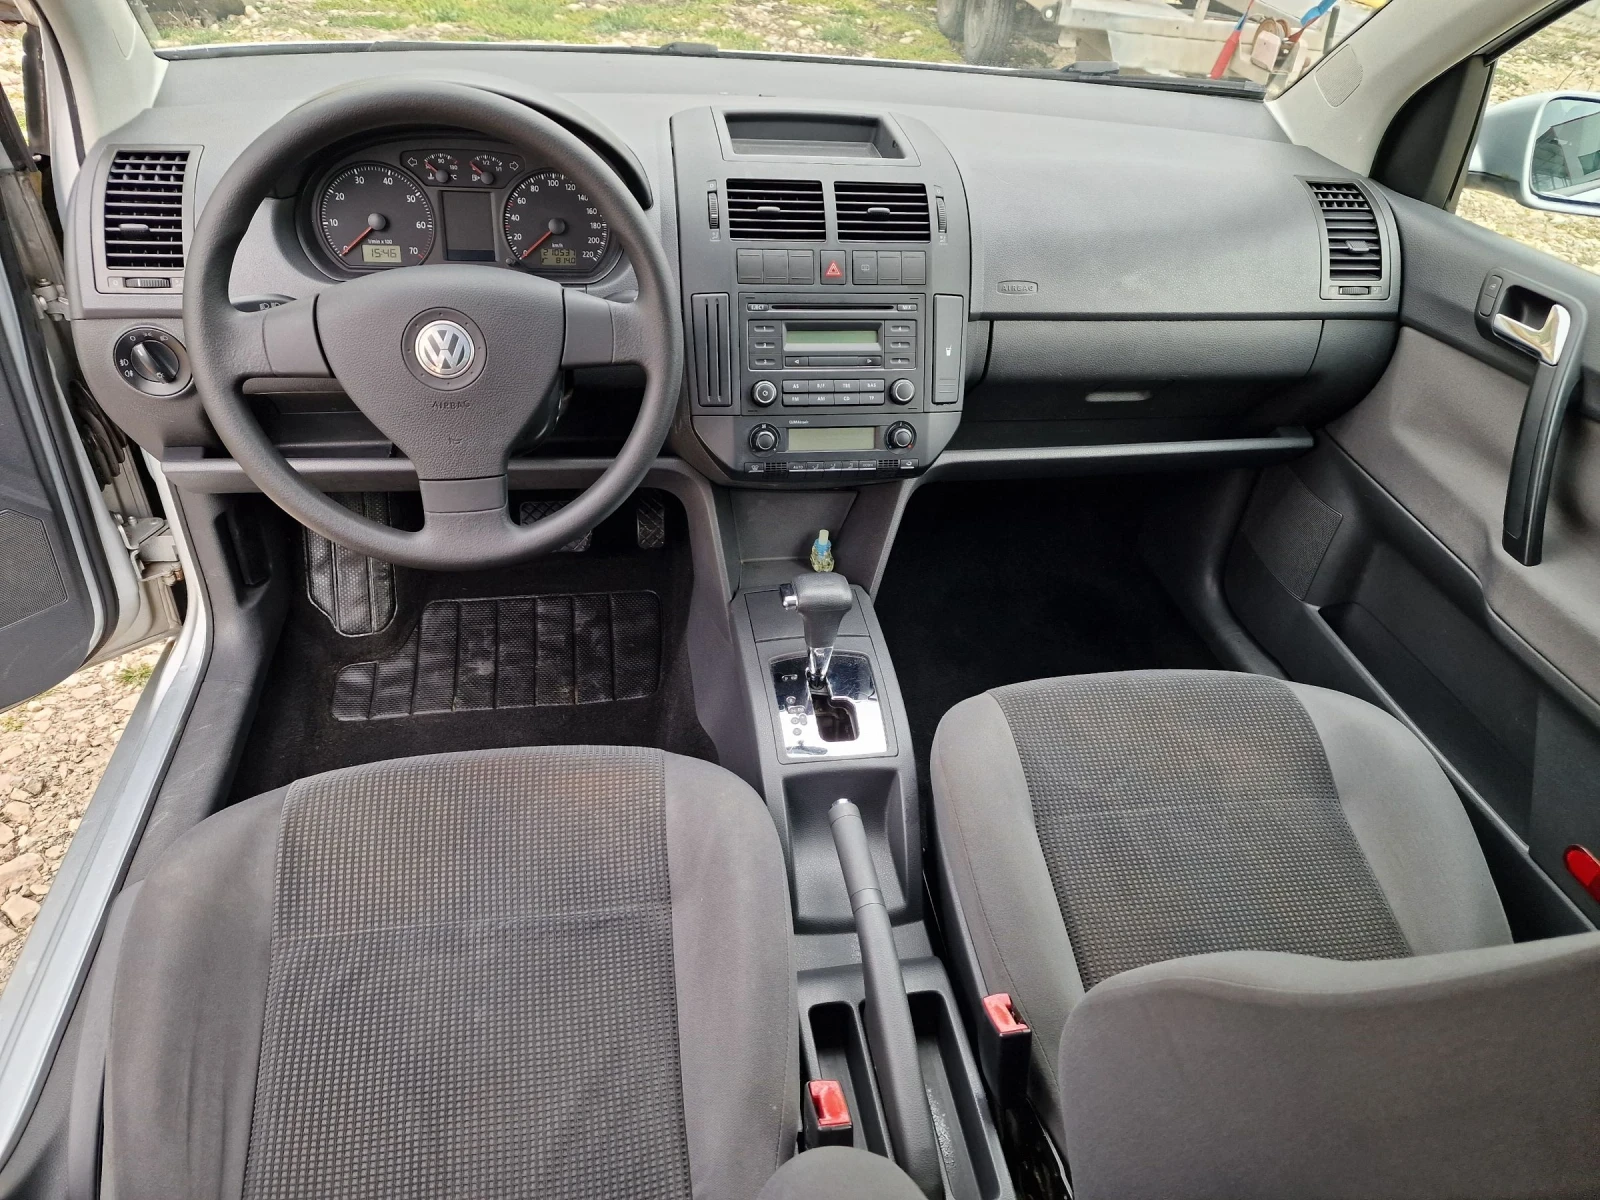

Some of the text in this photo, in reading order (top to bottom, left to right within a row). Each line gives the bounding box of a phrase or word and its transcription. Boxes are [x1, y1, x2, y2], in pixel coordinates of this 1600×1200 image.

[336, 192, 344, 200] 20
[590, 222, 601, 230] 180
[372, 248, 396, 258] 15:46
[432, 401, 470, 409] AIRBAG
